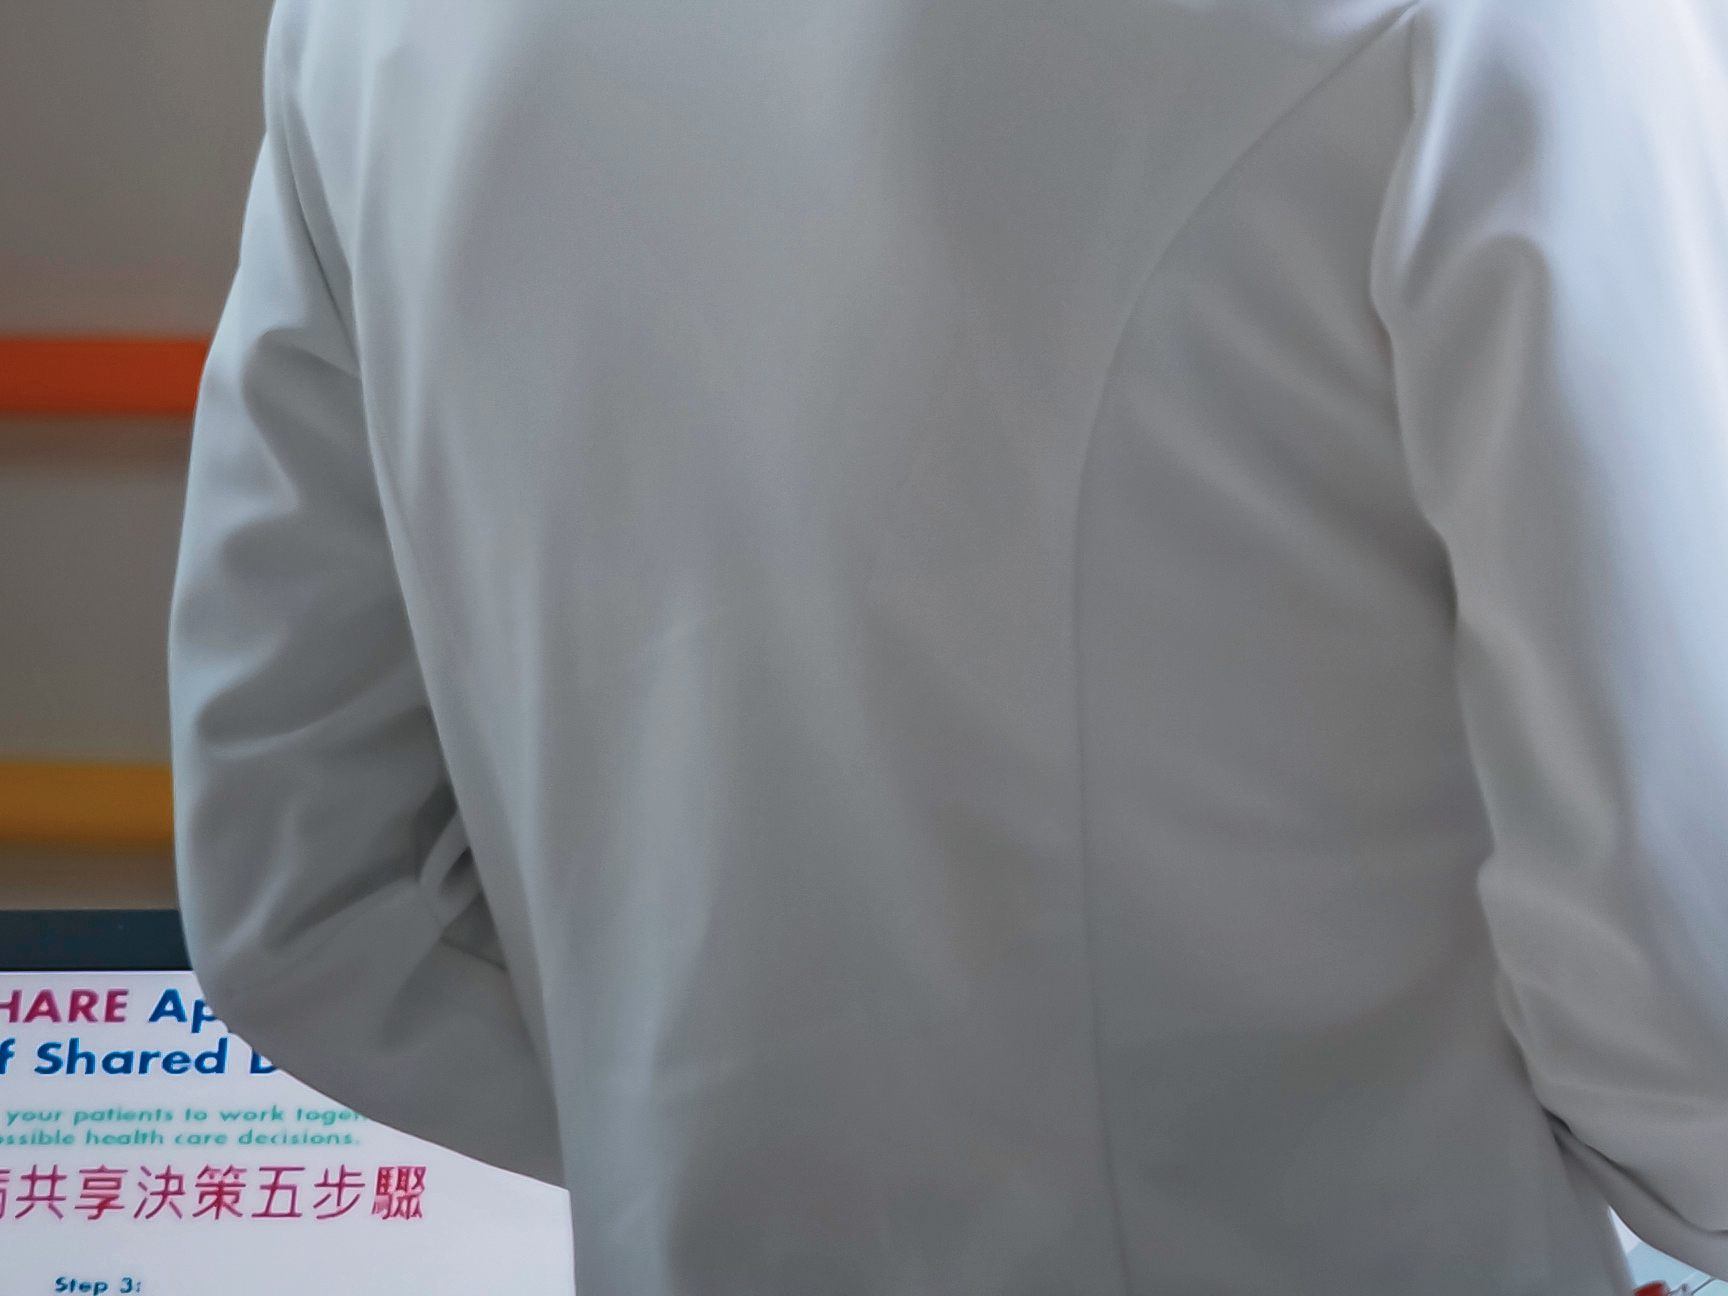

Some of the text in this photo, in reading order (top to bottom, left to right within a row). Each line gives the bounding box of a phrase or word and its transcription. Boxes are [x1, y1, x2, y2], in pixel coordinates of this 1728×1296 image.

[33, 1037, 228, 1075] Shared
[7, 1111, 61, 1126] your
[73, 1108, 173, 1125] patients
[185, 1108, 208, 1122] to
[220, 1106, 284, 1122] work
[85, 1128, 163, 1145] health
[175, 1133, 228, 1145] care
[0, 1164, 427, 1220] 共享決策五步驟
[55, 1276, 109, 1296] Step
